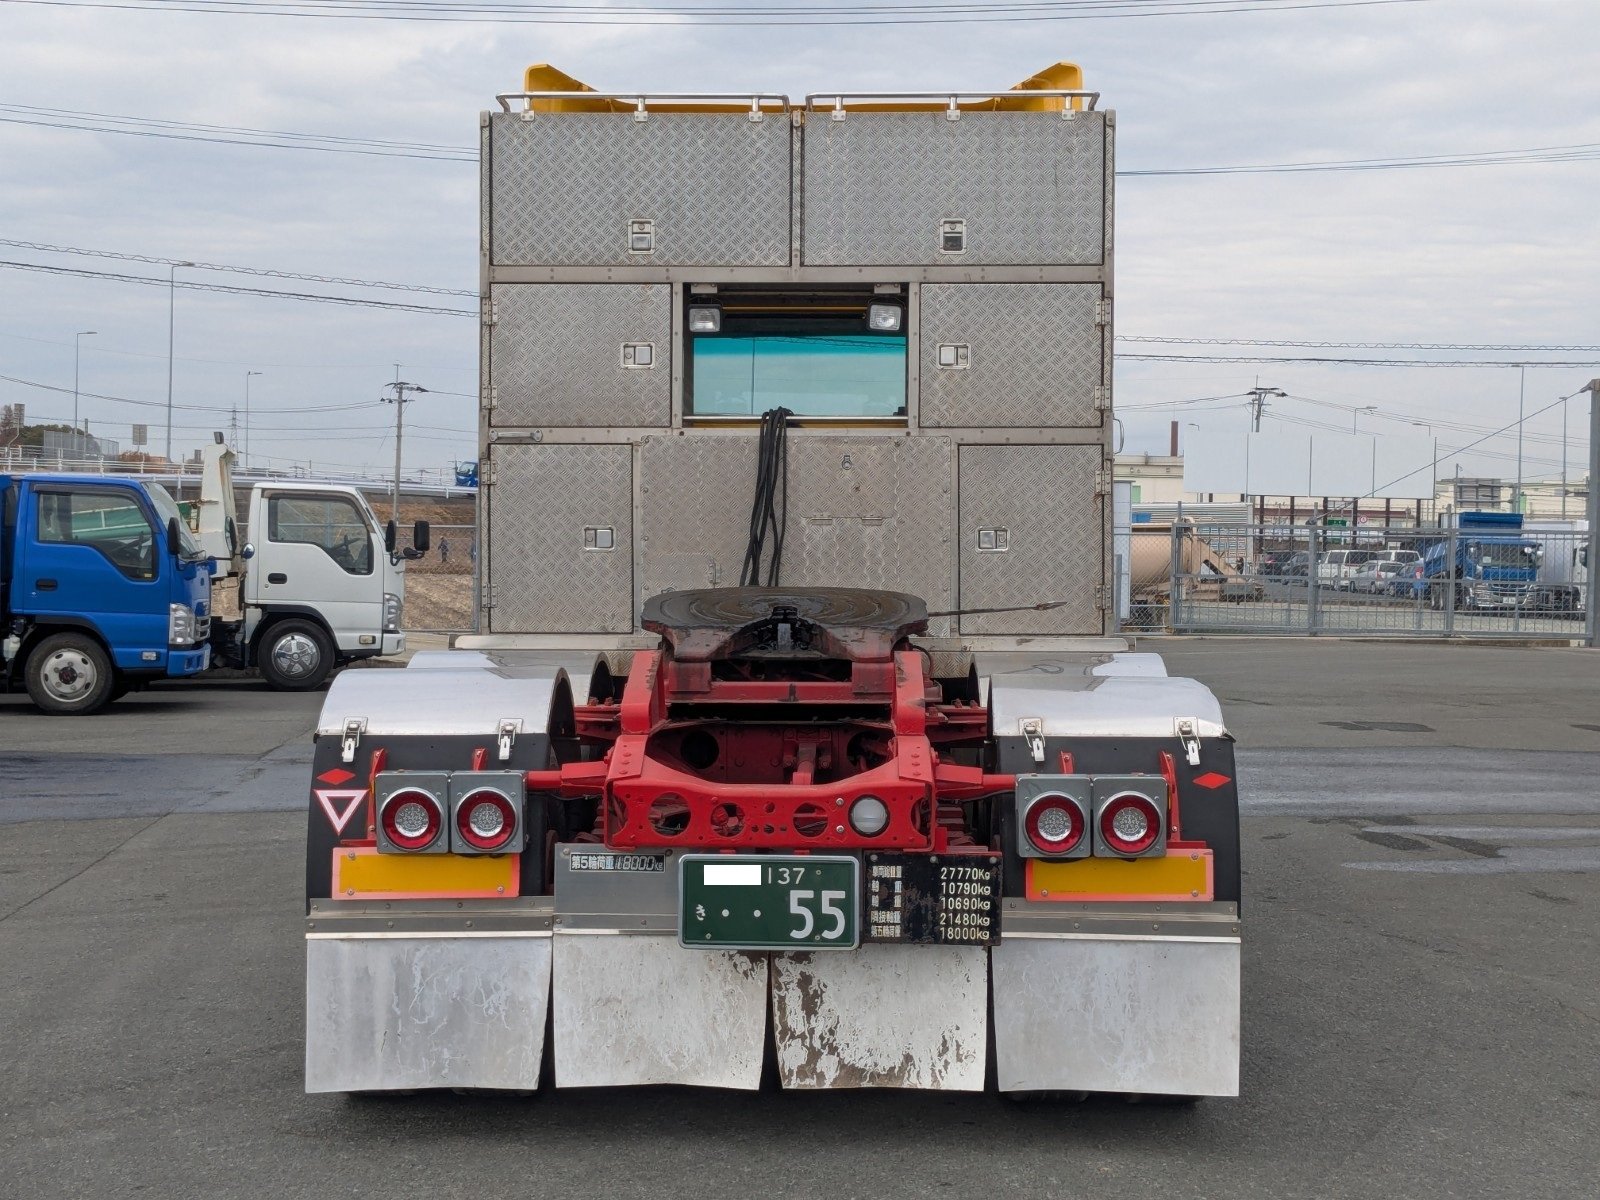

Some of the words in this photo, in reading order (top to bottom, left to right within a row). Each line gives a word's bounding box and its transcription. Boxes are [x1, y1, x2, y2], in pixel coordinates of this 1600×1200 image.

[767, 866, 805, 884] 137
[941, 882, 991, 895] 10790kg
[941, 897, 991, 910] 10690kg
[695, 904, 706, 921] き
[940, 913, 990, 926] 21480kg
[940, 927, 990, 940] 18000kg
